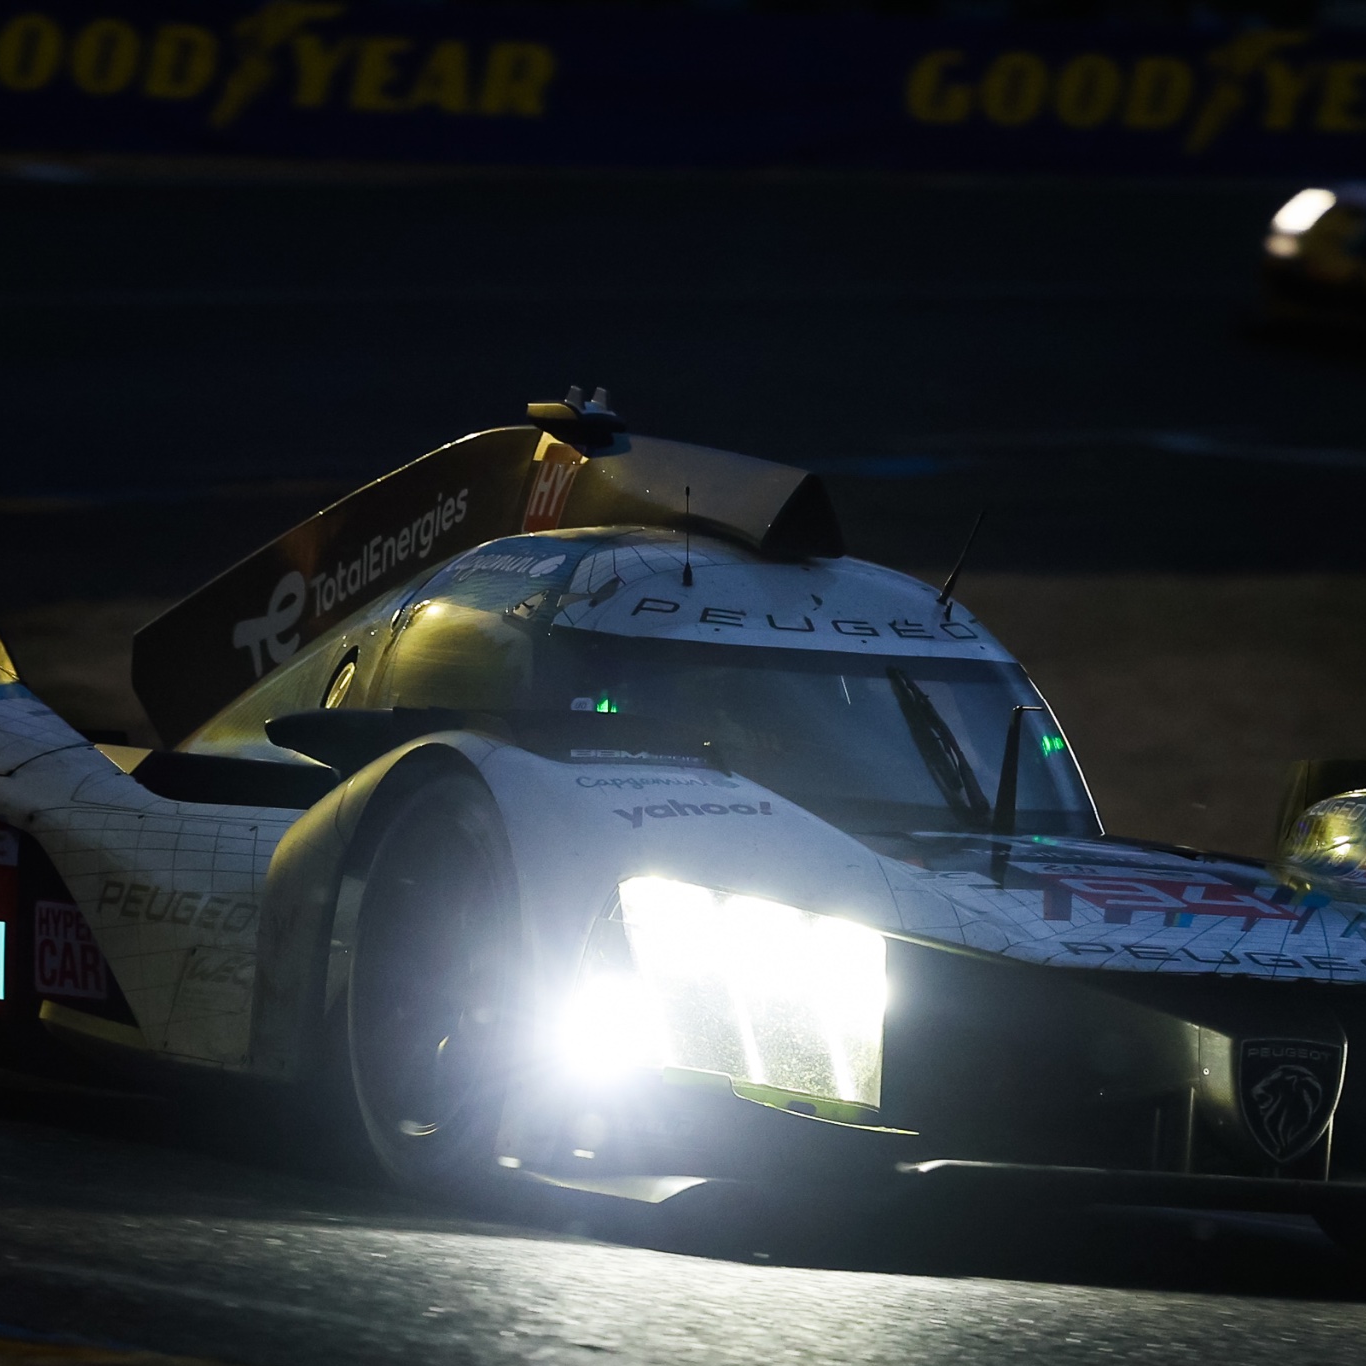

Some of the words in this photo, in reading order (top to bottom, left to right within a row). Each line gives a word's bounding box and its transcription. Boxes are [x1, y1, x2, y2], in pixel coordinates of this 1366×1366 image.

[529, 461, 575, 516] HY
[309, 488, 469, 617] TotalEnergies
[631, 598, 978, 639] PEUGEO
[614, 799, 773, 829] yahoo!
[97, 880, 258, 933] PEUGEO
[1059, 878, 1285, 916] 94
[37, 905, 92, 943] HYPE
[37, 938, 103, 993] CAR
[1247, 1047, 1331, 1061] PEUGEOT
